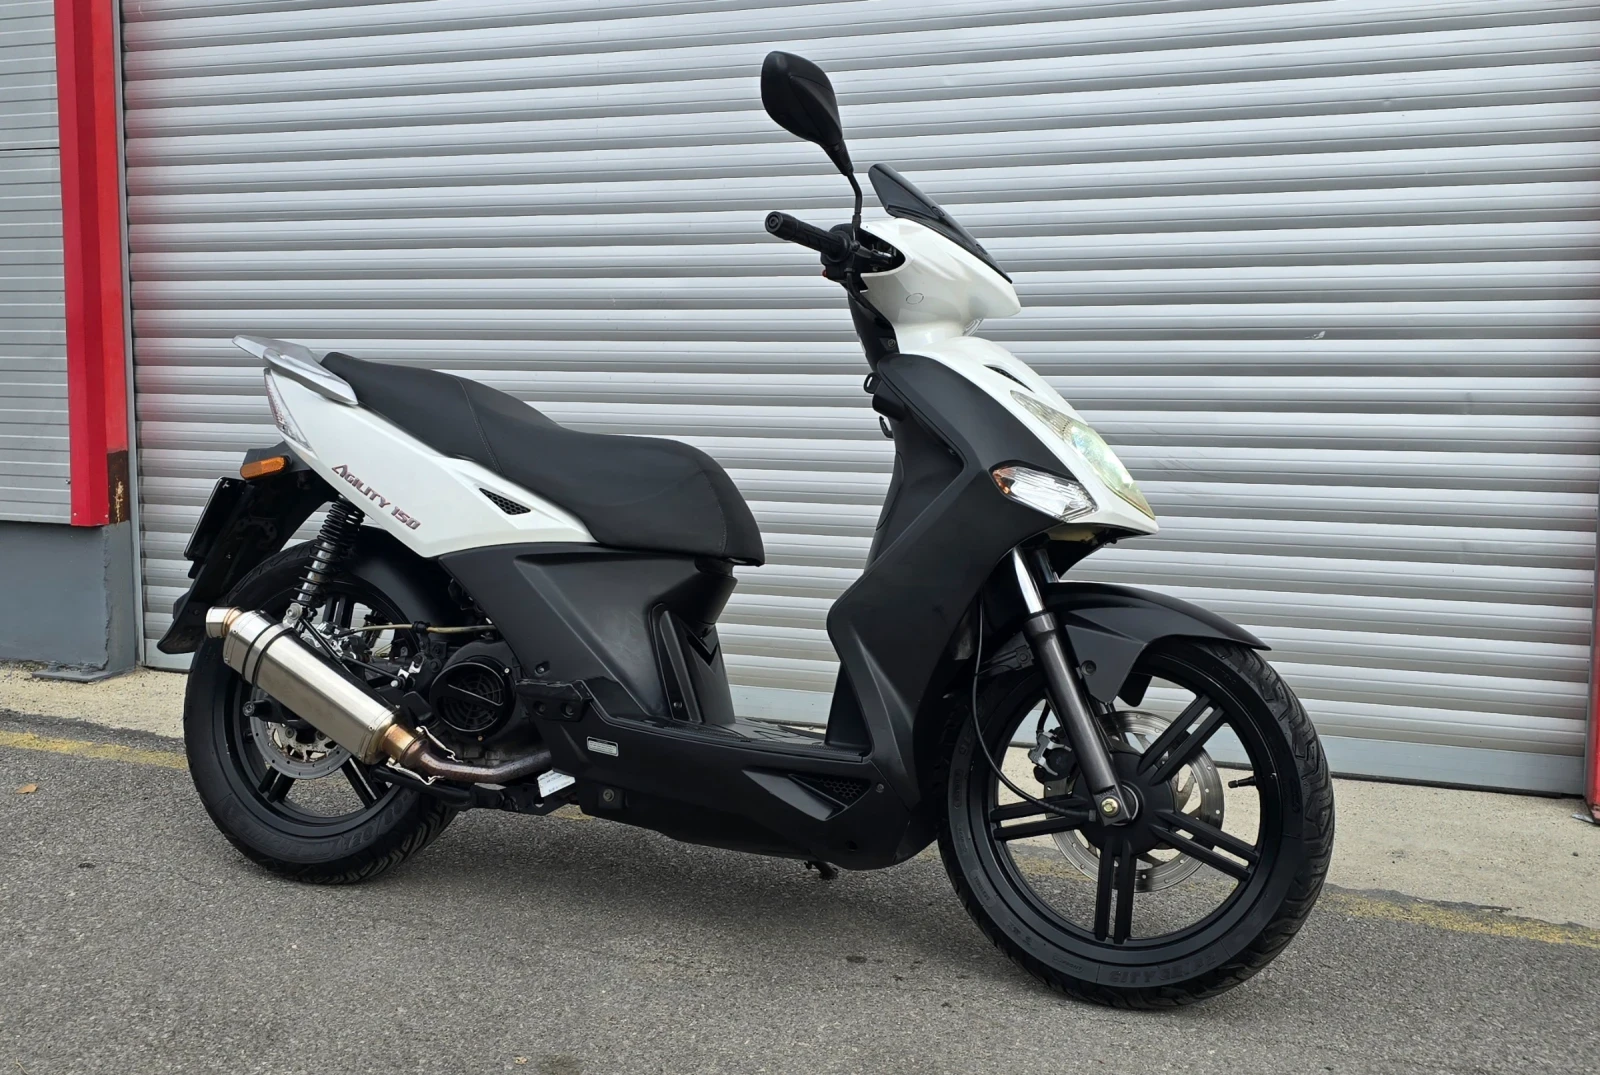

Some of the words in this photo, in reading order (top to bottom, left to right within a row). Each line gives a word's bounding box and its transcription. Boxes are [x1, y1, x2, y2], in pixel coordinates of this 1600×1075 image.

[331, 464, 391, 508] AGILITY
[391, 506, 421, 530] 150
[1109, 970, 1156, 983] CITY
